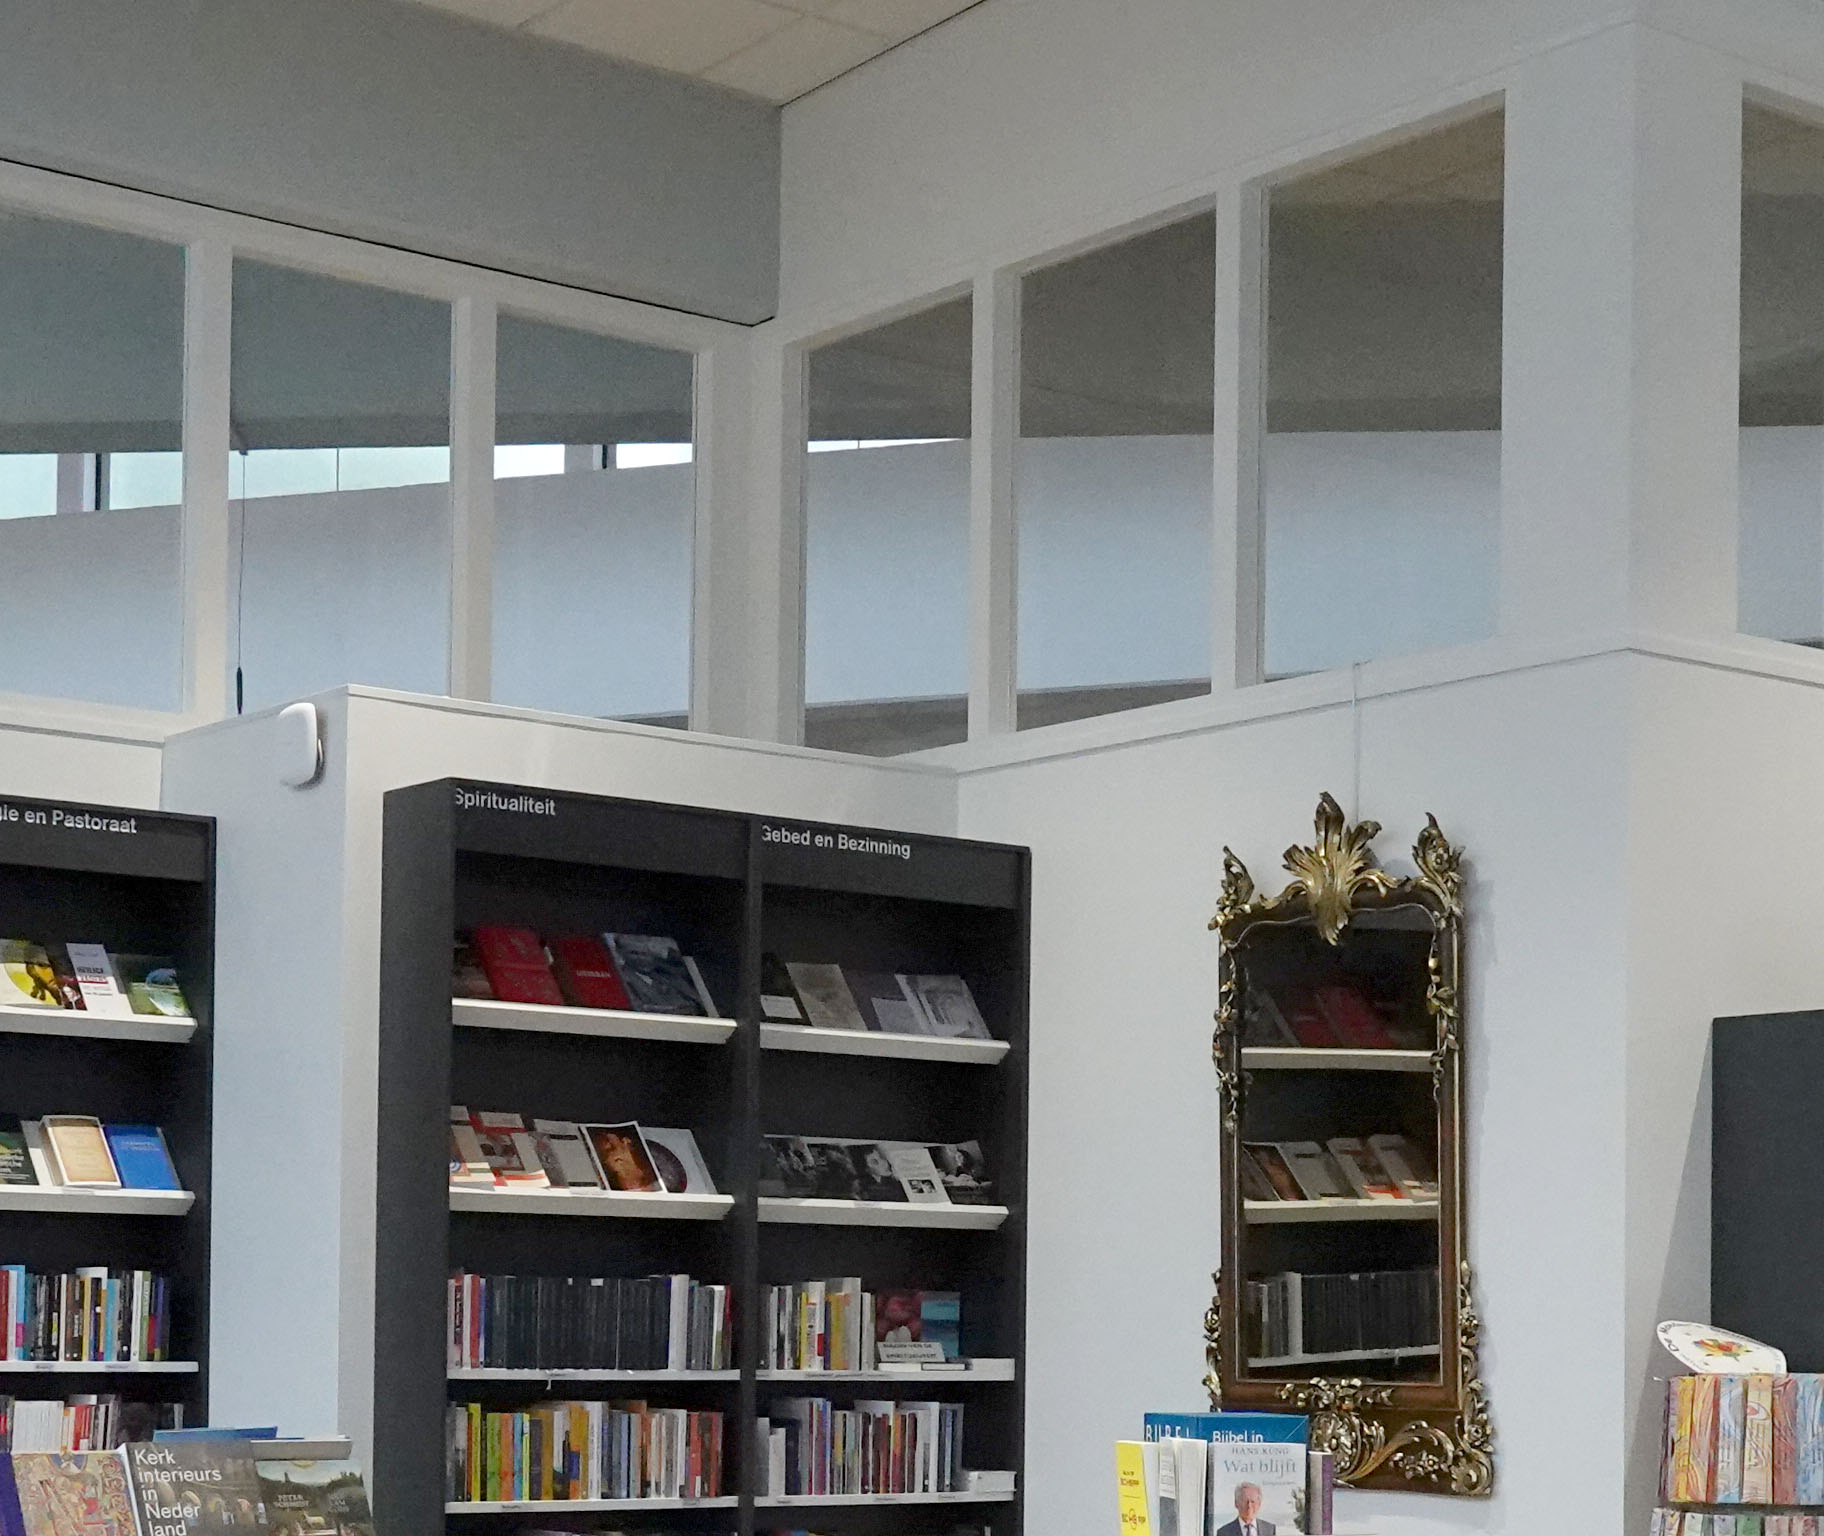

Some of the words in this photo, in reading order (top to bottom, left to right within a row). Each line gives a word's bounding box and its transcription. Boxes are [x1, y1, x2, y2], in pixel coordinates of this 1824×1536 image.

[455, 787, 556, 817] Spiritualiteit
[25, 810, 46, 824] en
[52, 809, 137, 834] Pastoraat
[762, 825, 810, 846] Gebed
[815, 833, 833, 849] en
[838, 834, 911, 860] Bezinning
[134, 1448, 176, 1466] Kerk
[137, 1468, 223, 1483] interieurs
[1224, 1459, 1256, 1473] Wat
[1259, 1459, 1297, 1479] blijft
[142, 1486, 158, 1501] in
[145, 1503, 201, 1519] Neder
